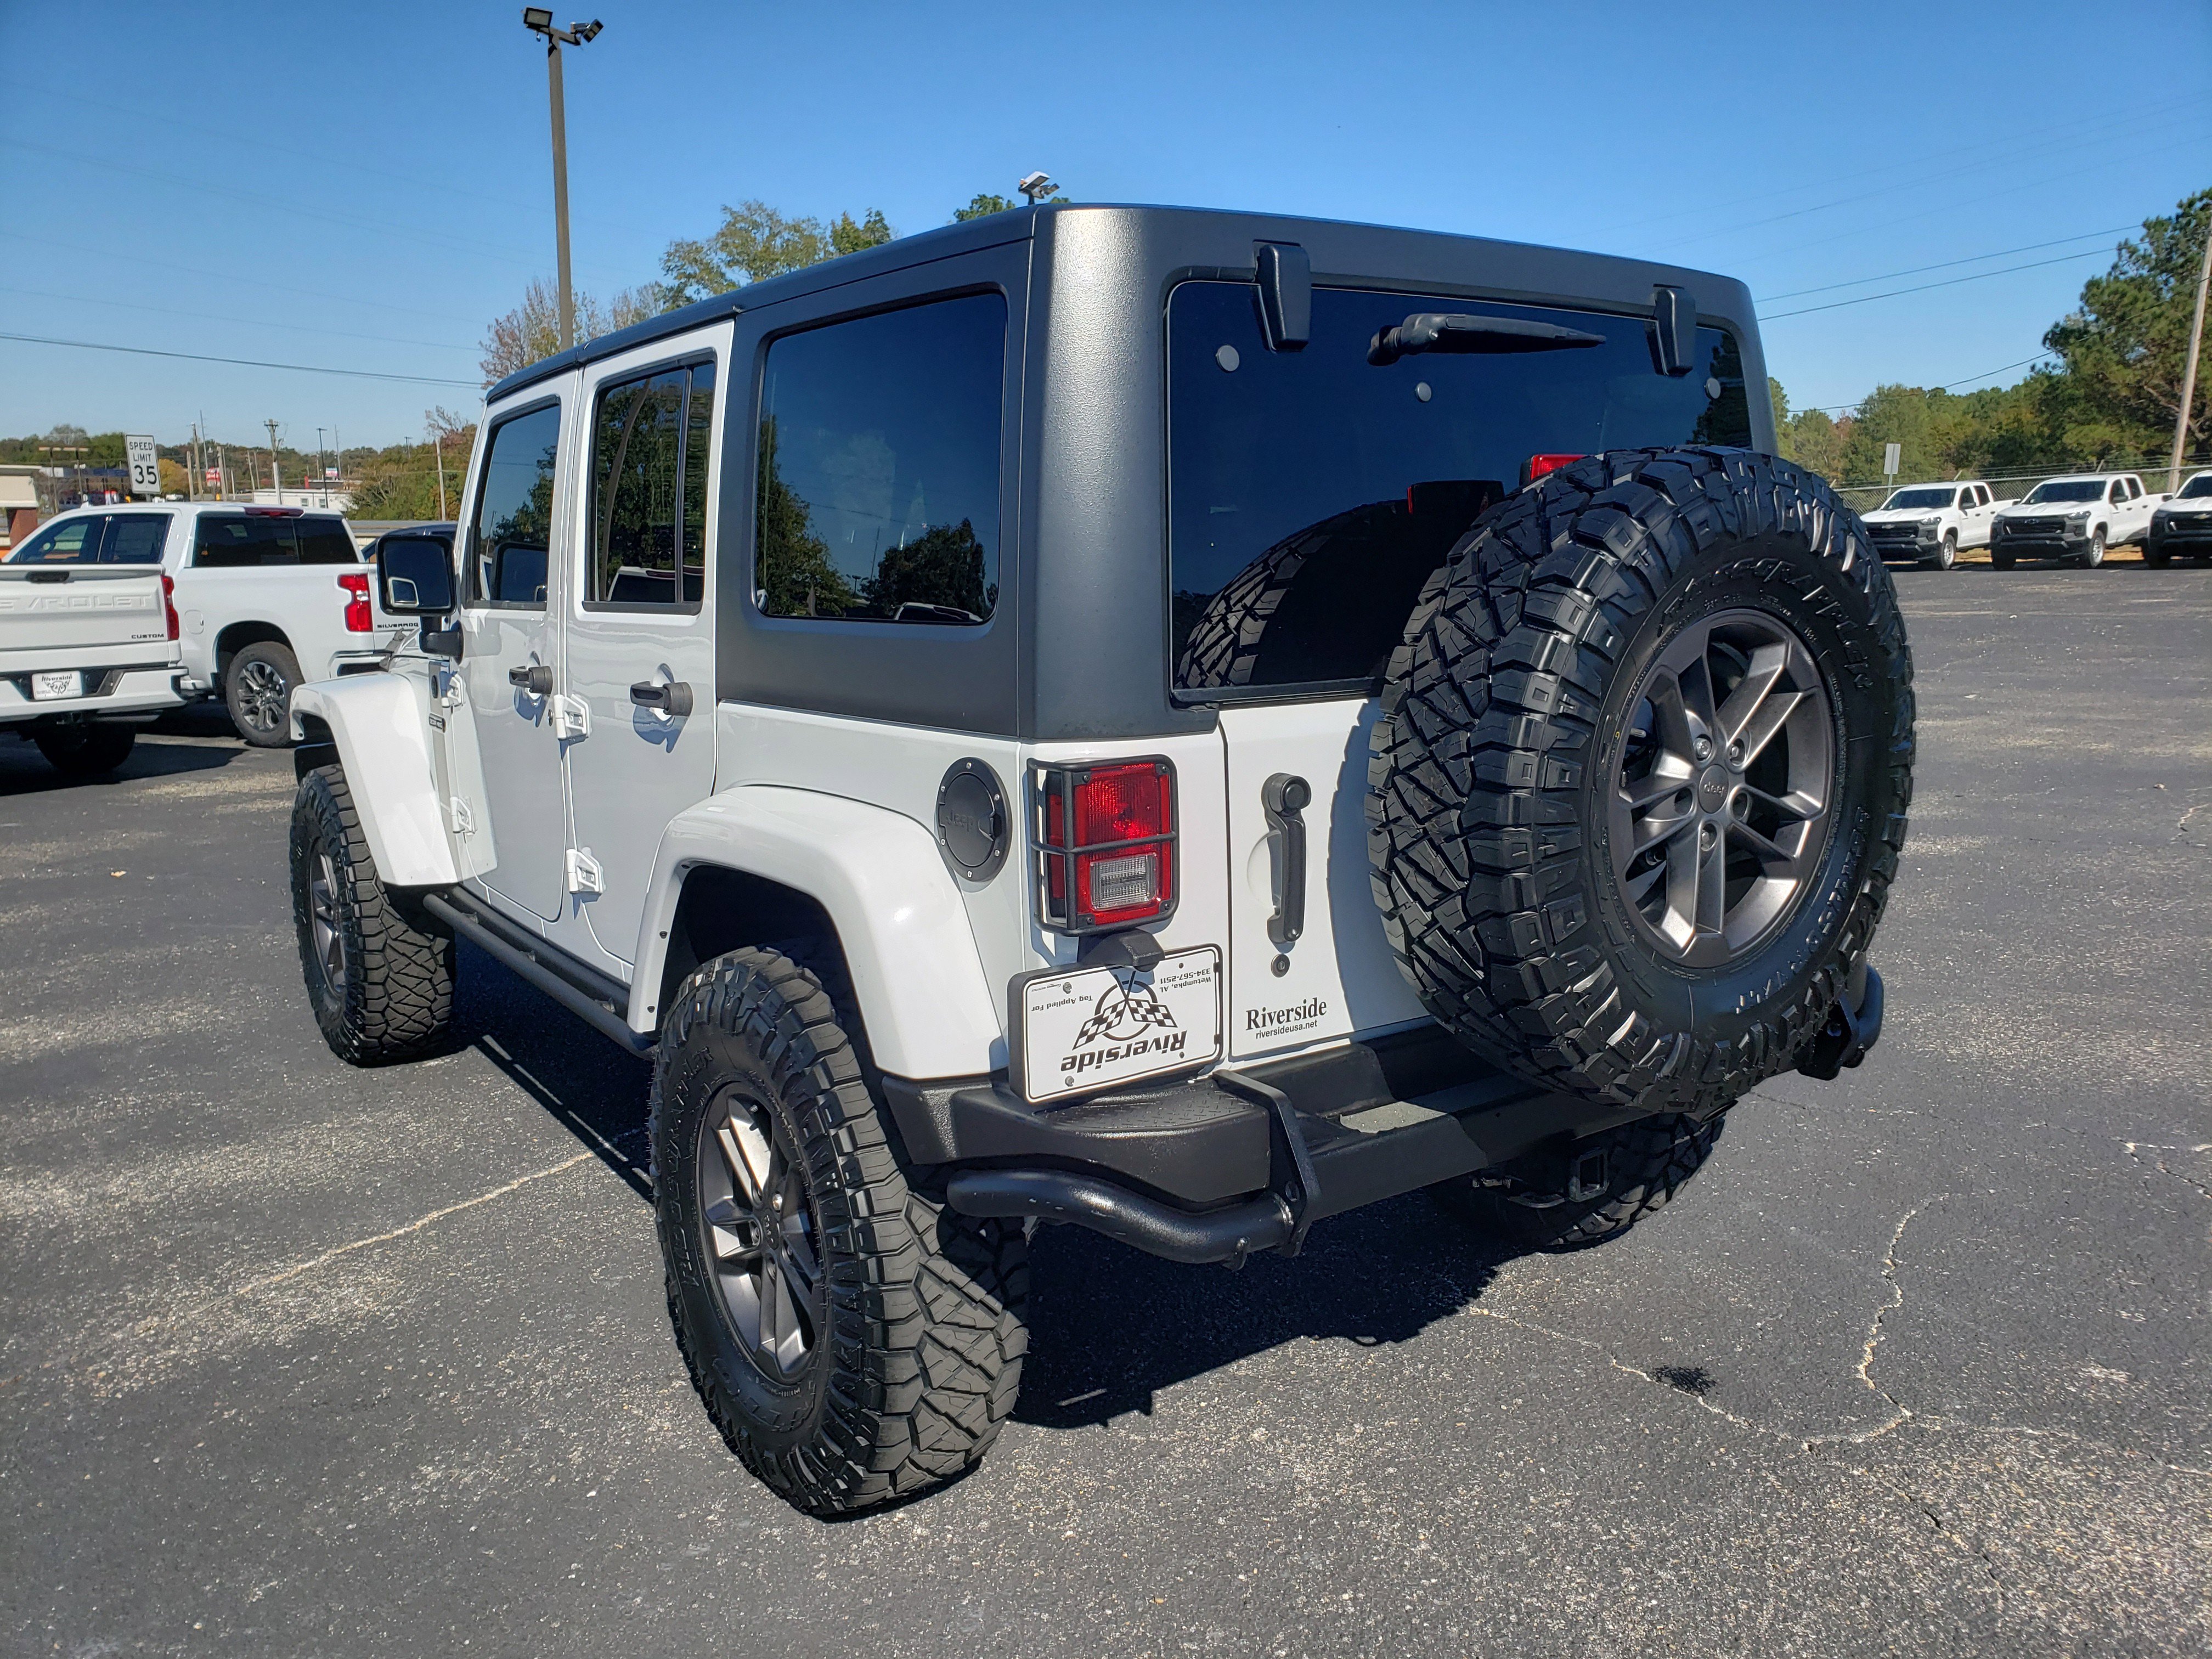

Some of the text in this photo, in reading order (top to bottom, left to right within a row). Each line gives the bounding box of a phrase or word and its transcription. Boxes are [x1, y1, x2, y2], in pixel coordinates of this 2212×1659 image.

[129, 442, 153, 450] SPEED
[133, 453, 151, 462] LIMIT
[134, 465, 157, 484] 35
[946, 809, 974, 832] Jeep
[1160, 968, 1211, 984] 334-567-2511
[1172, 977, 1211, 989] Wetumpka,
[1047, 998, 1076, 1009] Applied
[1246, 997, 1327, 1030] Riverside
[1256, 1019, 1317, 1039] riversideusa.net
[1060, 1030, 1187, 1073] Riverside
